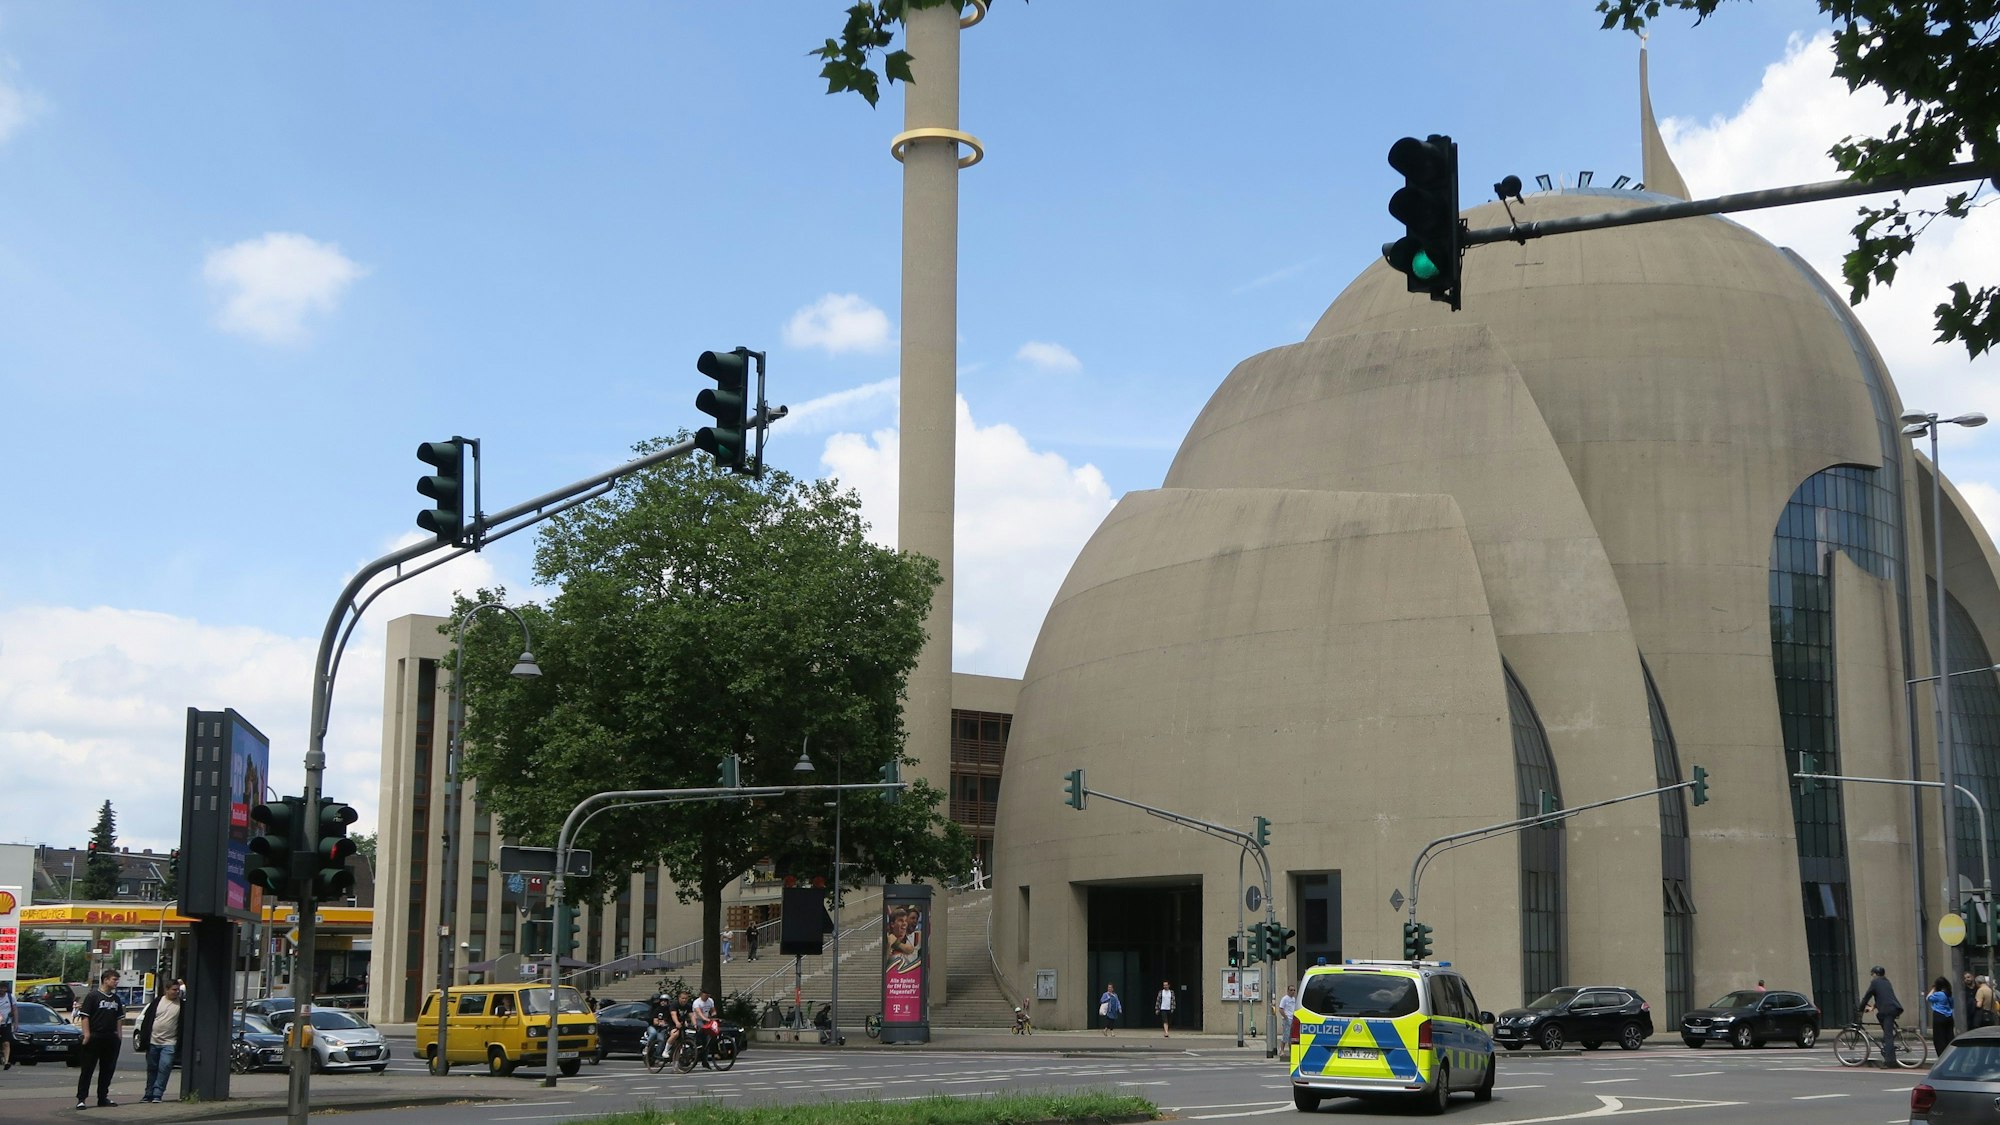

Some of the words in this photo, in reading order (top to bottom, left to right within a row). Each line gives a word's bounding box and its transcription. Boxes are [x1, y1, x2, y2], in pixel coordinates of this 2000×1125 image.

[86, 910, 137, 923] Shell
[893, 1004, 900, 1013] T
[1301, 1024, 1343, 1035] POLIZEI
